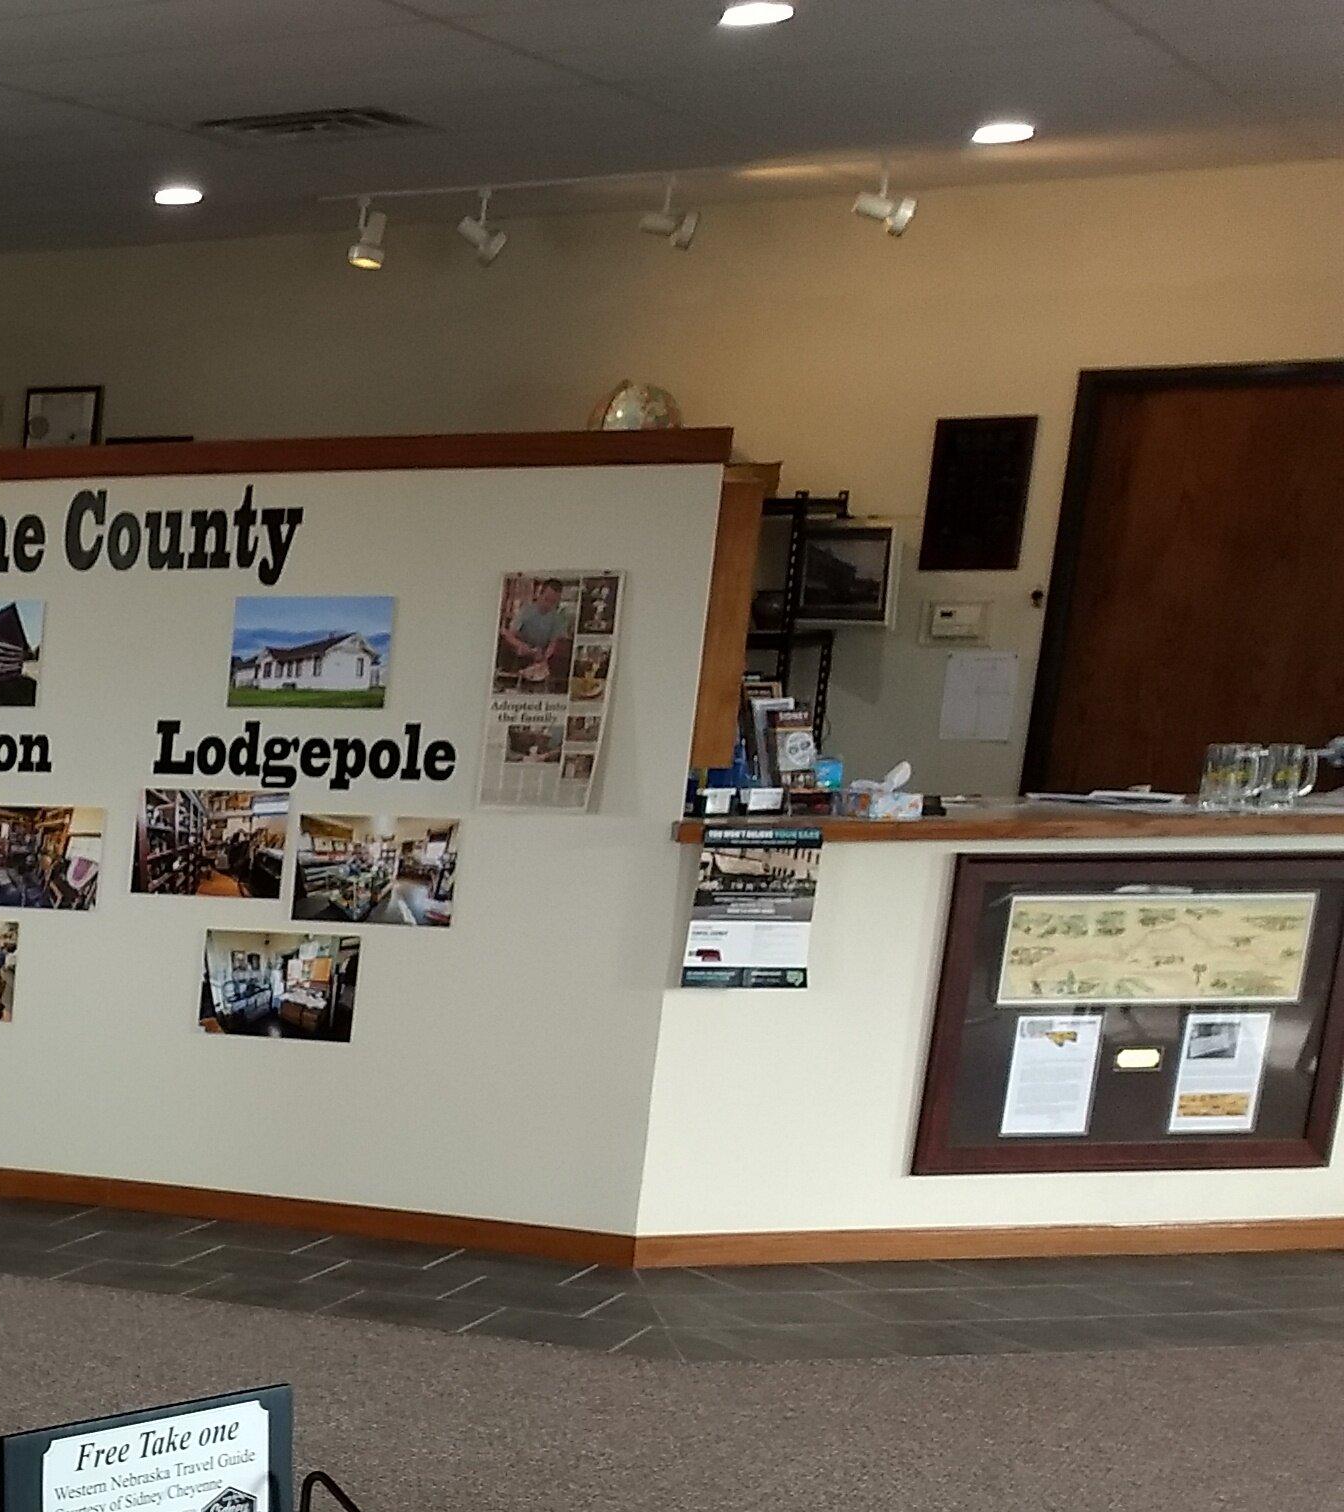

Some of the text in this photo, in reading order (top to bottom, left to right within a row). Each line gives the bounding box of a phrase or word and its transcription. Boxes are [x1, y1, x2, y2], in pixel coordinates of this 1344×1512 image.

[65, 484, 304, 586] County
[490, 700, 542, 712] Adopted
[498, 711, 558, 722] the family
[153, 719, 456, 790] Lodgepole
[74, 1420, 240, 1472] Free Take one
[53, 1448, 256, 1502] Western Nebraska Travel Guide
[109, 1497, 122, 1512] of
[125, 1488, 163, 1507] Sidney
[166, 1477, 223, 1501] Cheyenne
